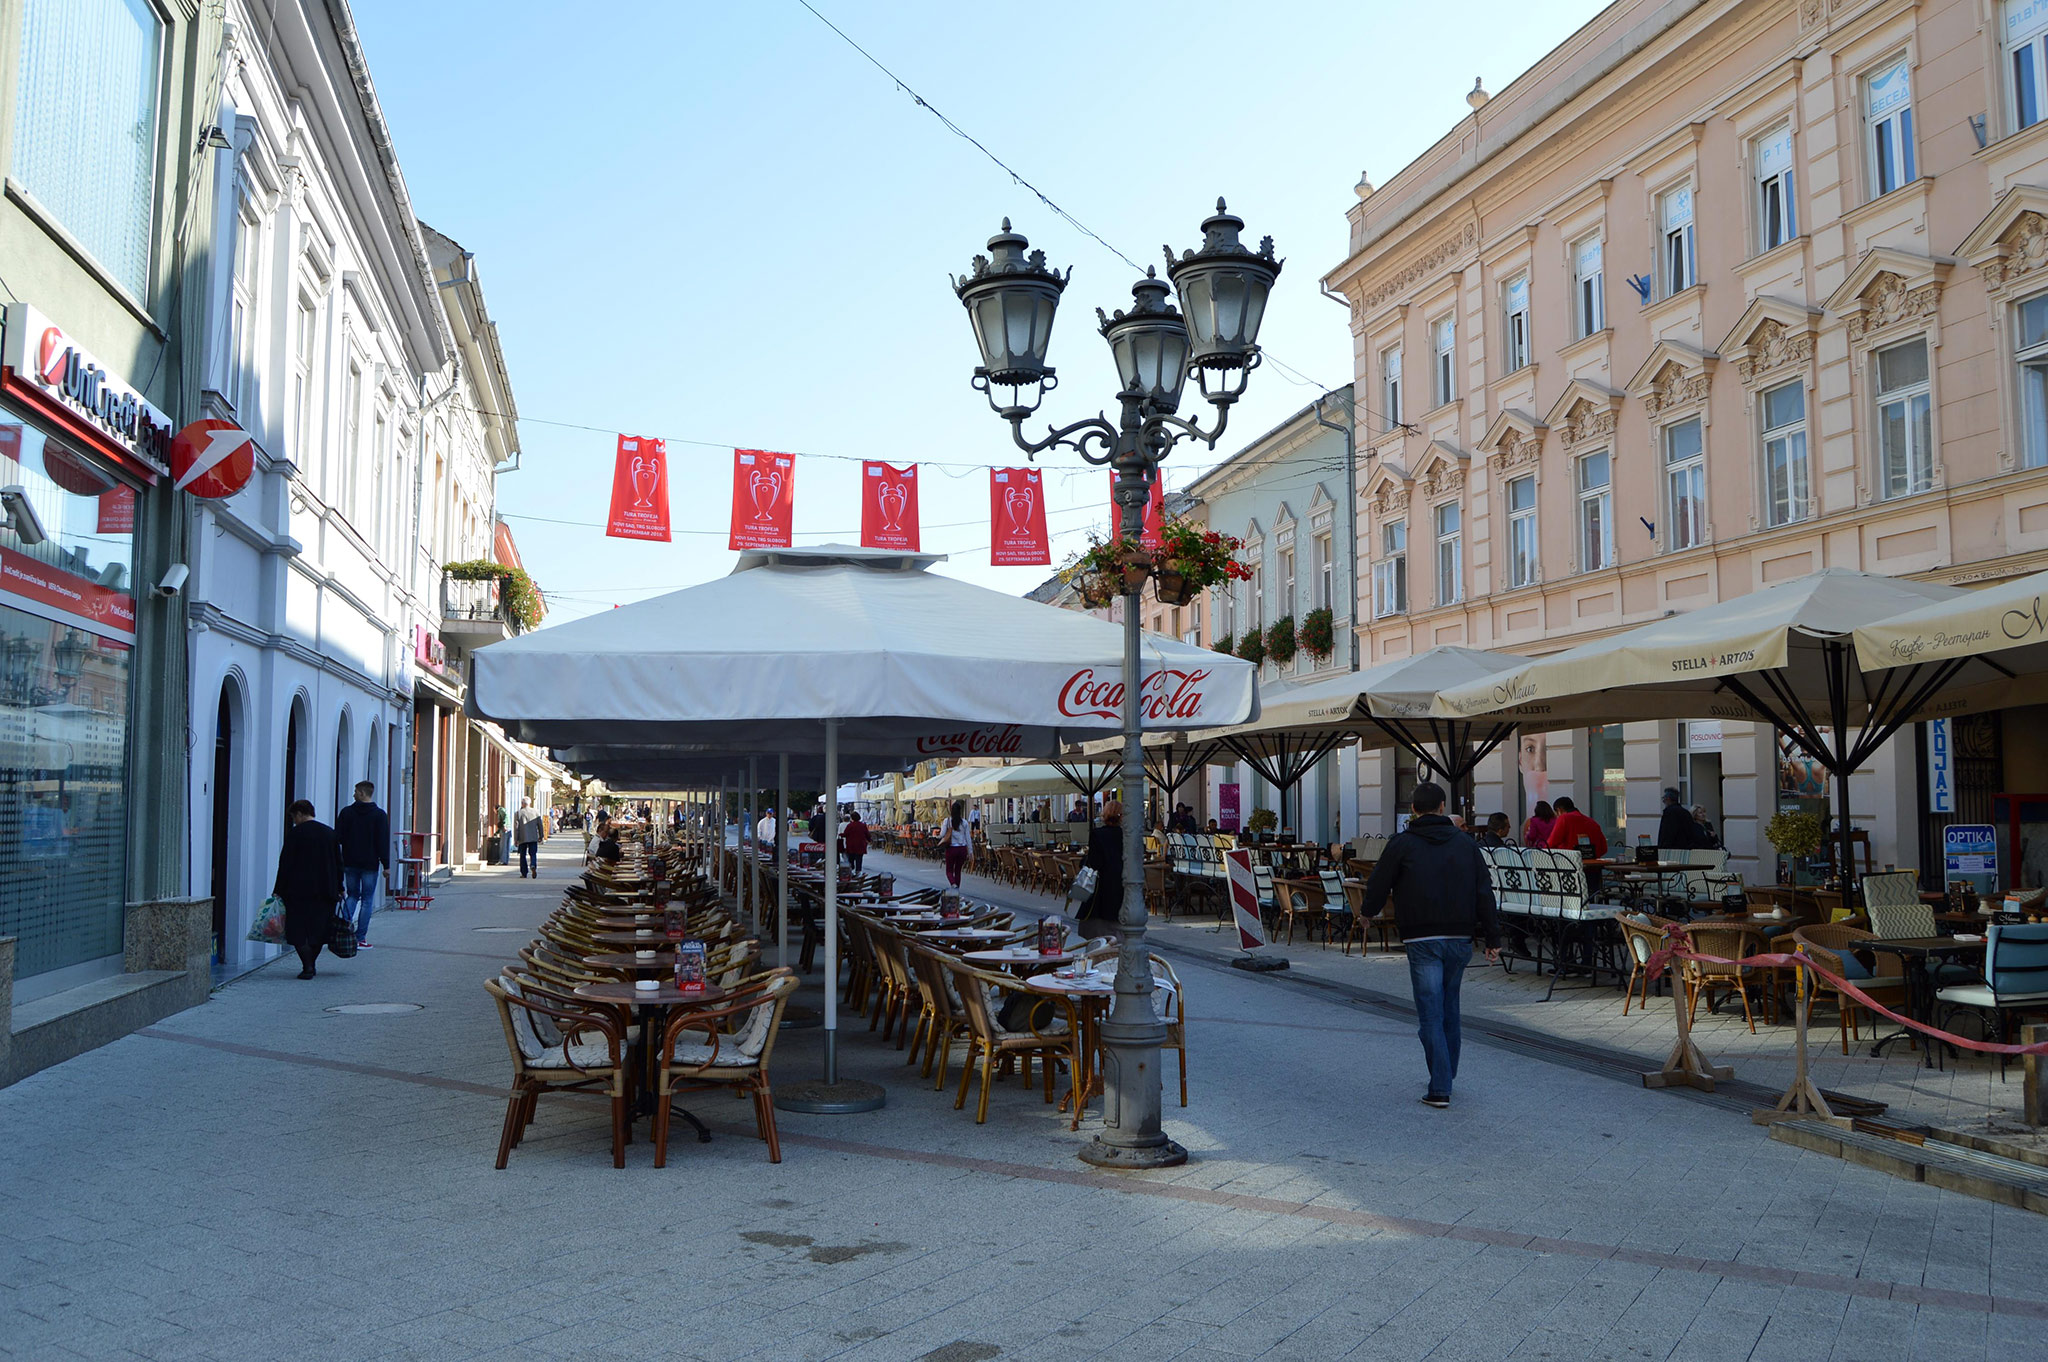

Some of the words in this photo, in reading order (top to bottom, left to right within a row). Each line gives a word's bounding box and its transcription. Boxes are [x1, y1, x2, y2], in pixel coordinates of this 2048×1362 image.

[1871, 87, 1909, 113] БЕСЕД
[64, 346, 137, 441] UniCredit
[1672, 657, 1707, 671] STELLA
[1719, 649, 1755, 666] ARTOIS
[1058, 669, 1212, 720] CocaCola
[1308, 709, 1325, 717] STELLA
[1330, 706, 1348, 715] ARTOI
[1691, 733, 1725, 741] POSLOVNICA
[1933, 718, 1949, 810] ROJAČ
[1947, 831, 1993, 843] OPTIKA
